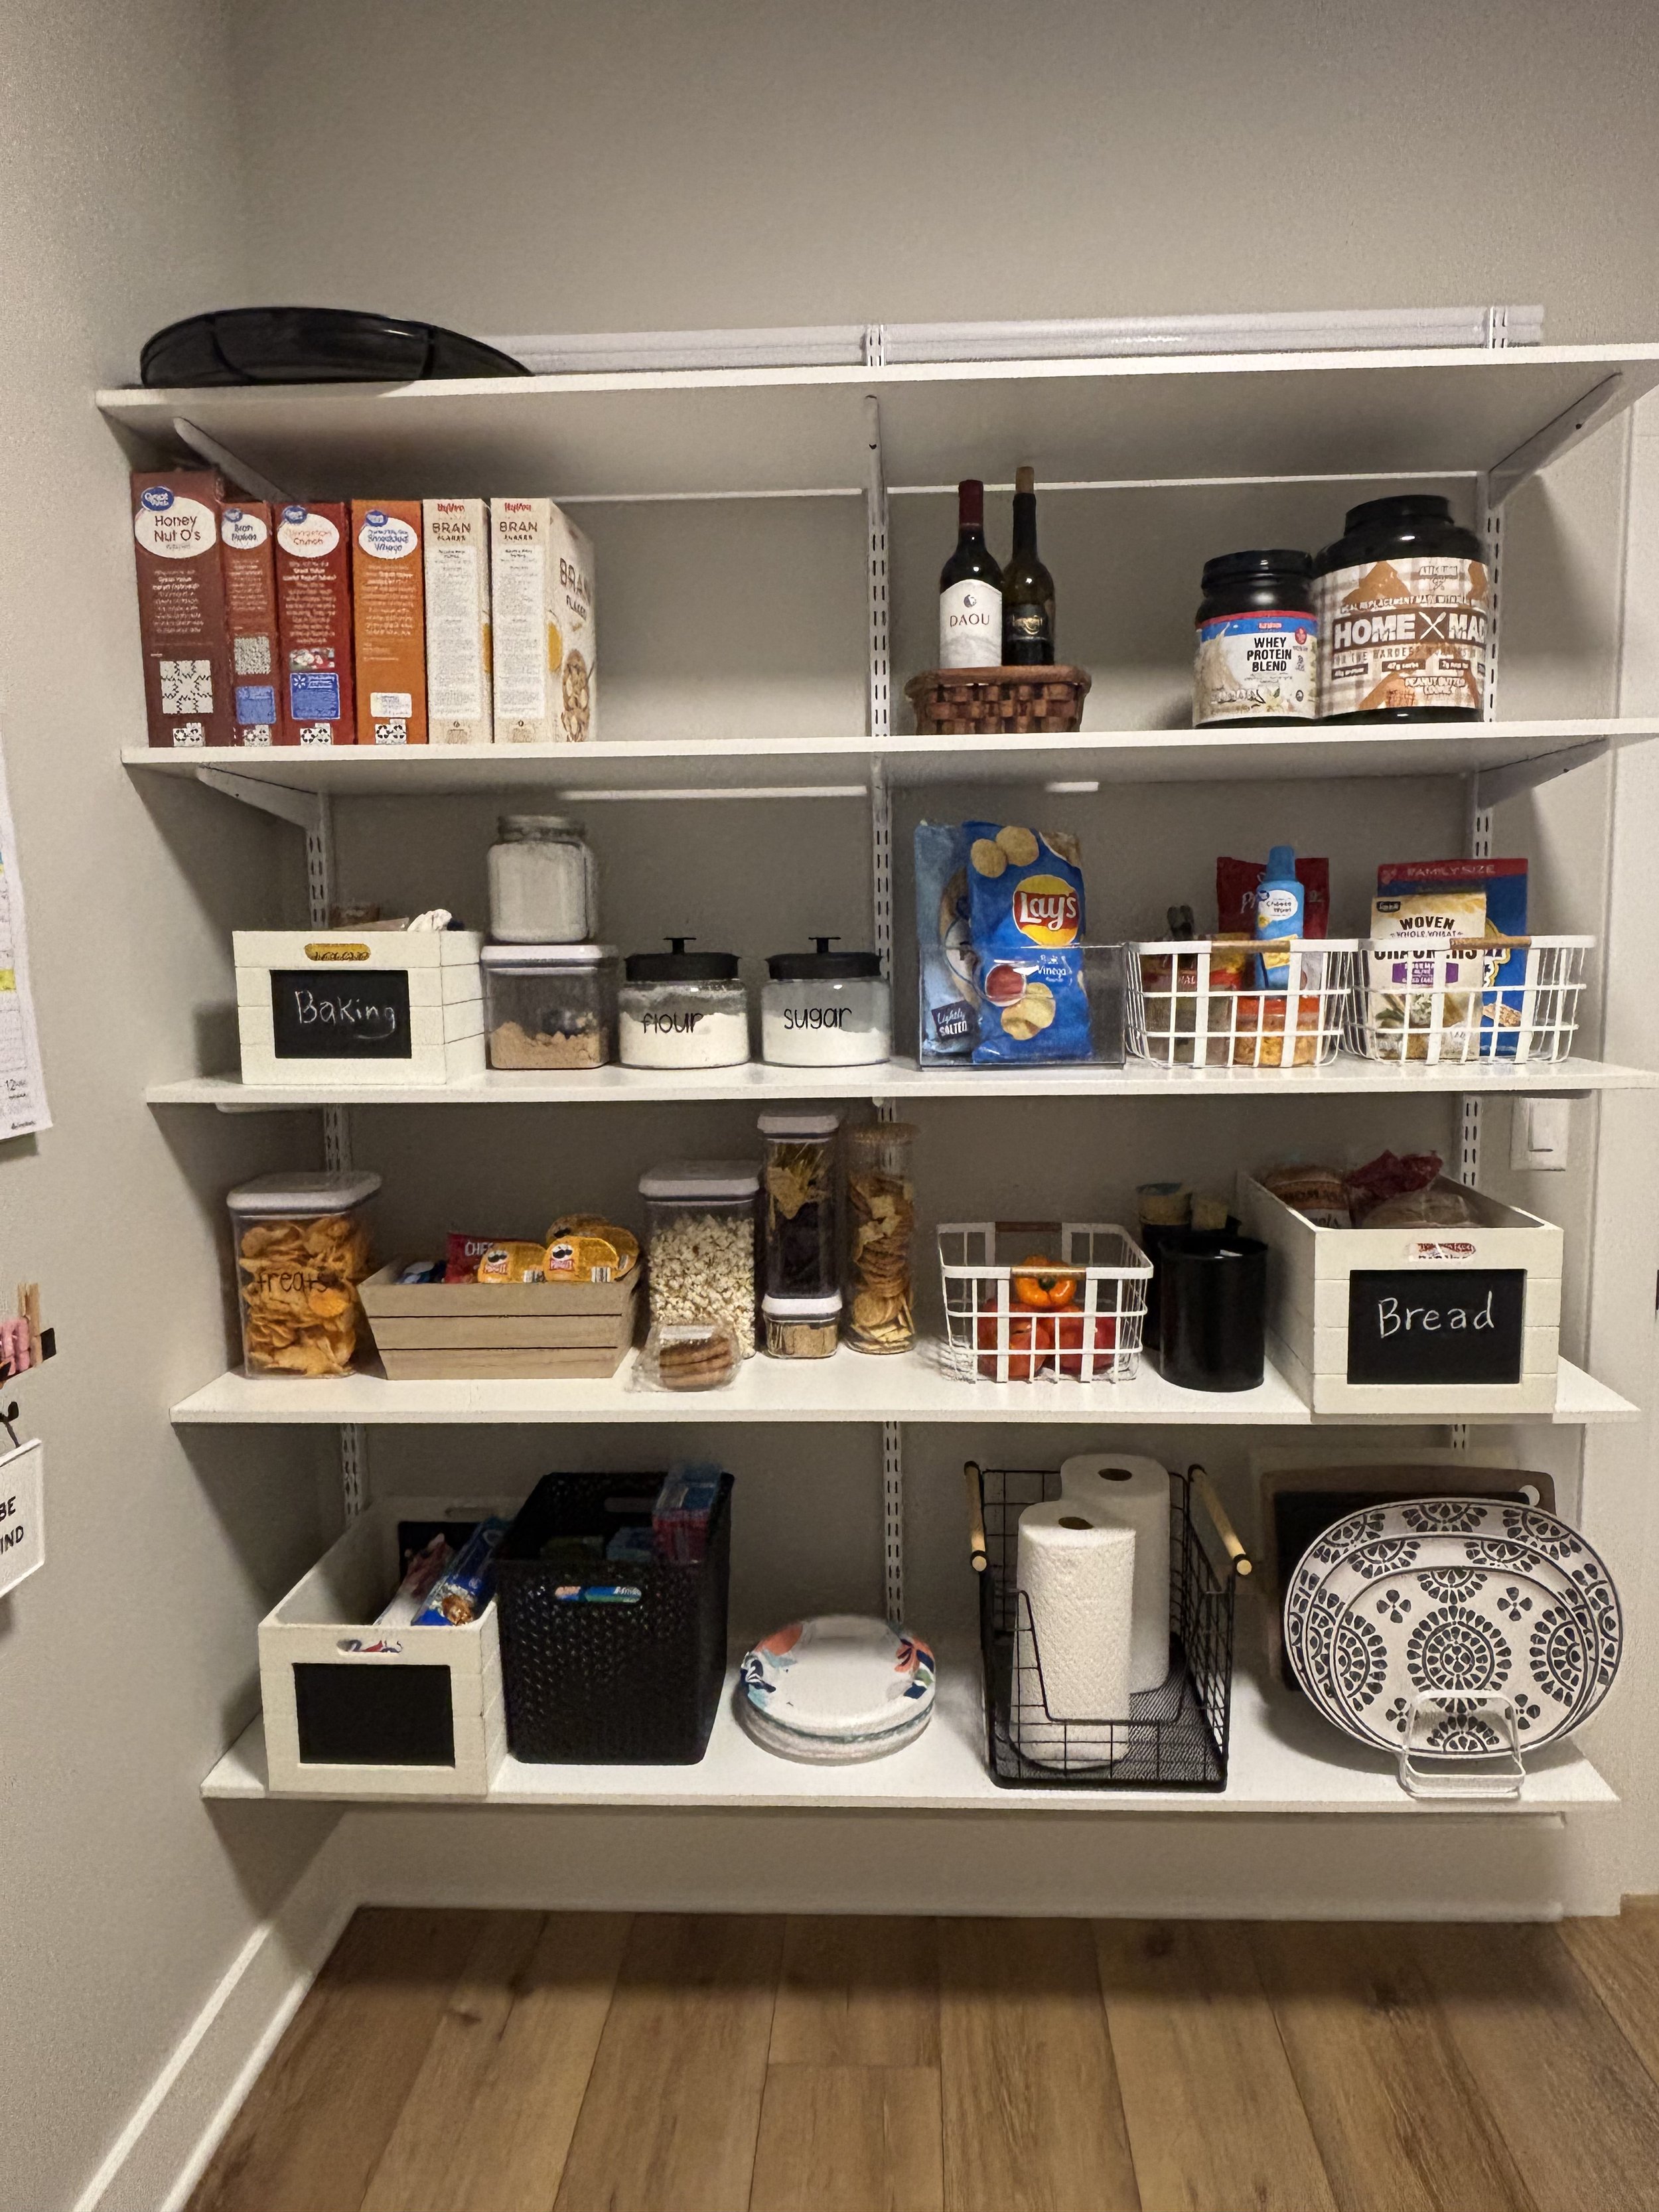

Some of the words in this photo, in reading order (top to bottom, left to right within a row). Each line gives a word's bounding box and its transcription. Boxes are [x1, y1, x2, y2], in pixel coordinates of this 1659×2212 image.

[155, 516, 197, 532] Honey
[433, 522, 471, 534] BRAN
[500, 521, 538, 532] BRAN
[154, 530, 177, 542] Nut
[950, 613, 990, 628] DAOU
[1334, 613, 1416, 649] HOME
[1254, 636, 1287, 648] WHEY
[1247, 649, 1292, 661] PROTEIN
[1252, 660, 1287, 672] BLEND
[1407, 867, 1457, 876] FAMILY
[1460, 865, 1496, 875] SIZE
[1020, 893, 1077, 930] Lay's
[1400, 916, 1455, 930] WOVEN
[295, 990, 396, 1040] Baking
[784, 1006, 852, 1031] sugar
[640, 1012, 704, 1034] flour
[1378, 1291, 1495, 1339] Bread
